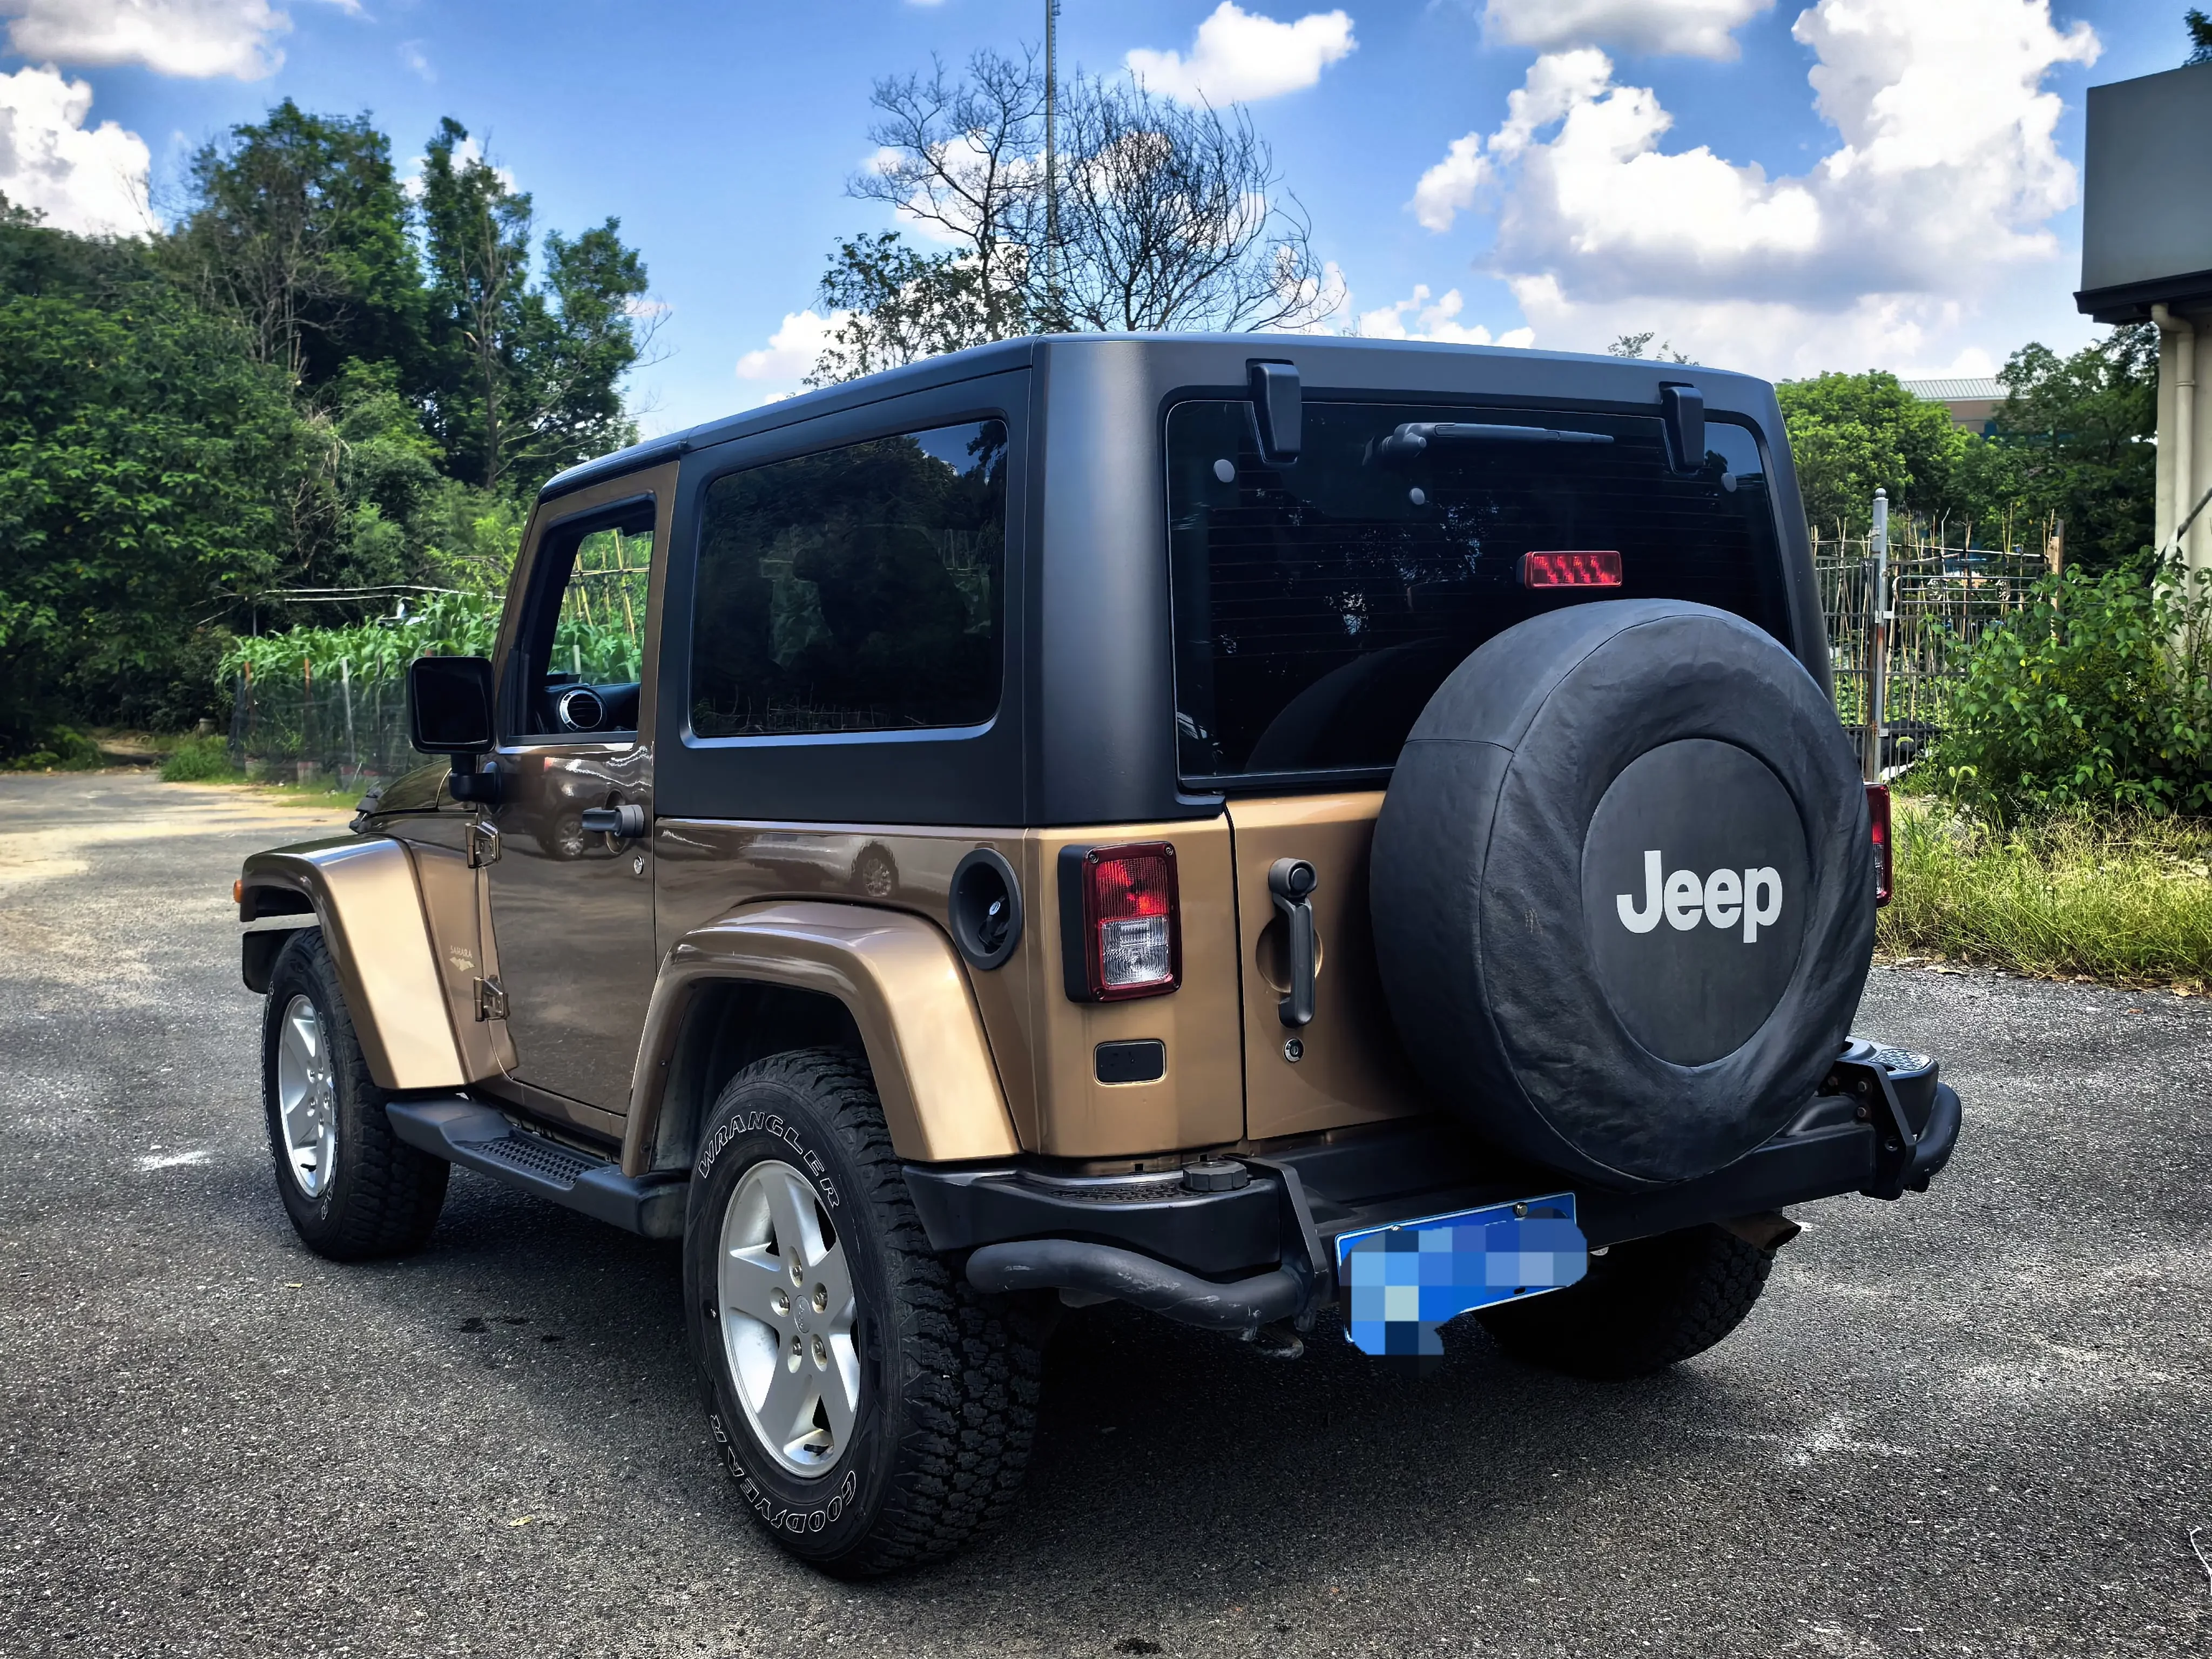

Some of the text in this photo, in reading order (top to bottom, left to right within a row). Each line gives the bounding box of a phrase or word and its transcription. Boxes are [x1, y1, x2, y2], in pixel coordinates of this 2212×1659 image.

[1616, 849, 1783, 943] Jeep
[698, 1111, 839, 1208] WRANGLER
[710, 1414, 856, 1533] GOODYEAR
